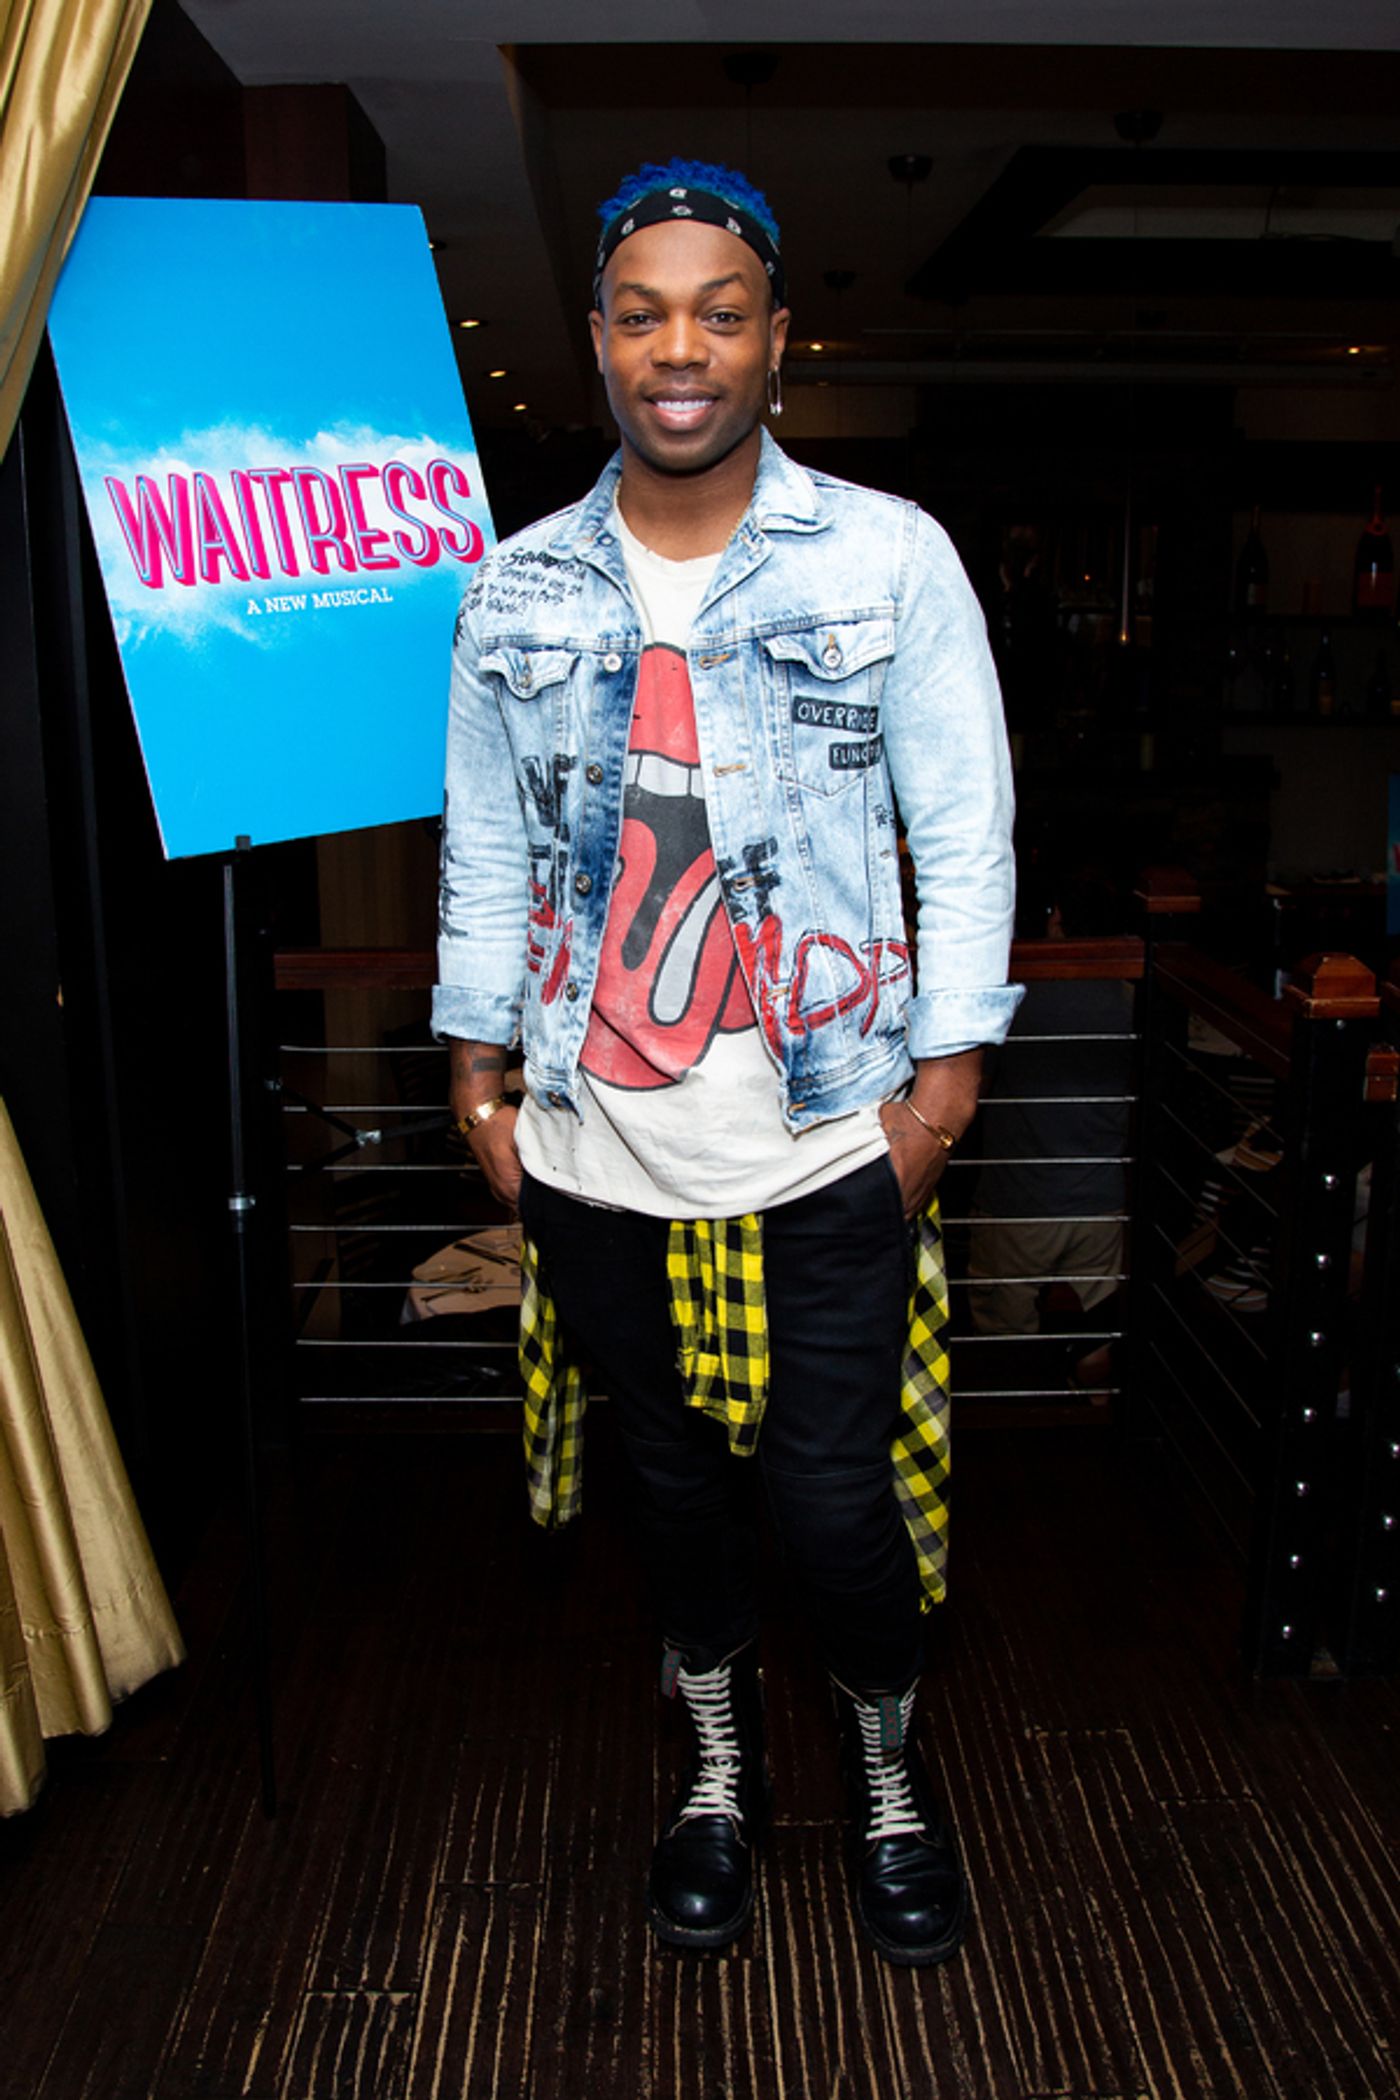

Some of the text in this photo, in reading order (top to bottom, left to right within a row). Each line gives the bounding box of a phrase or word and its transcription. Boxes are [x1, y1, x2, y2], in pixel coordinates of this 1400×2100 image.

[104, 459, 485, 589] WAITRESS
[247, 587, 394, 615] A NEW MUSICAL
